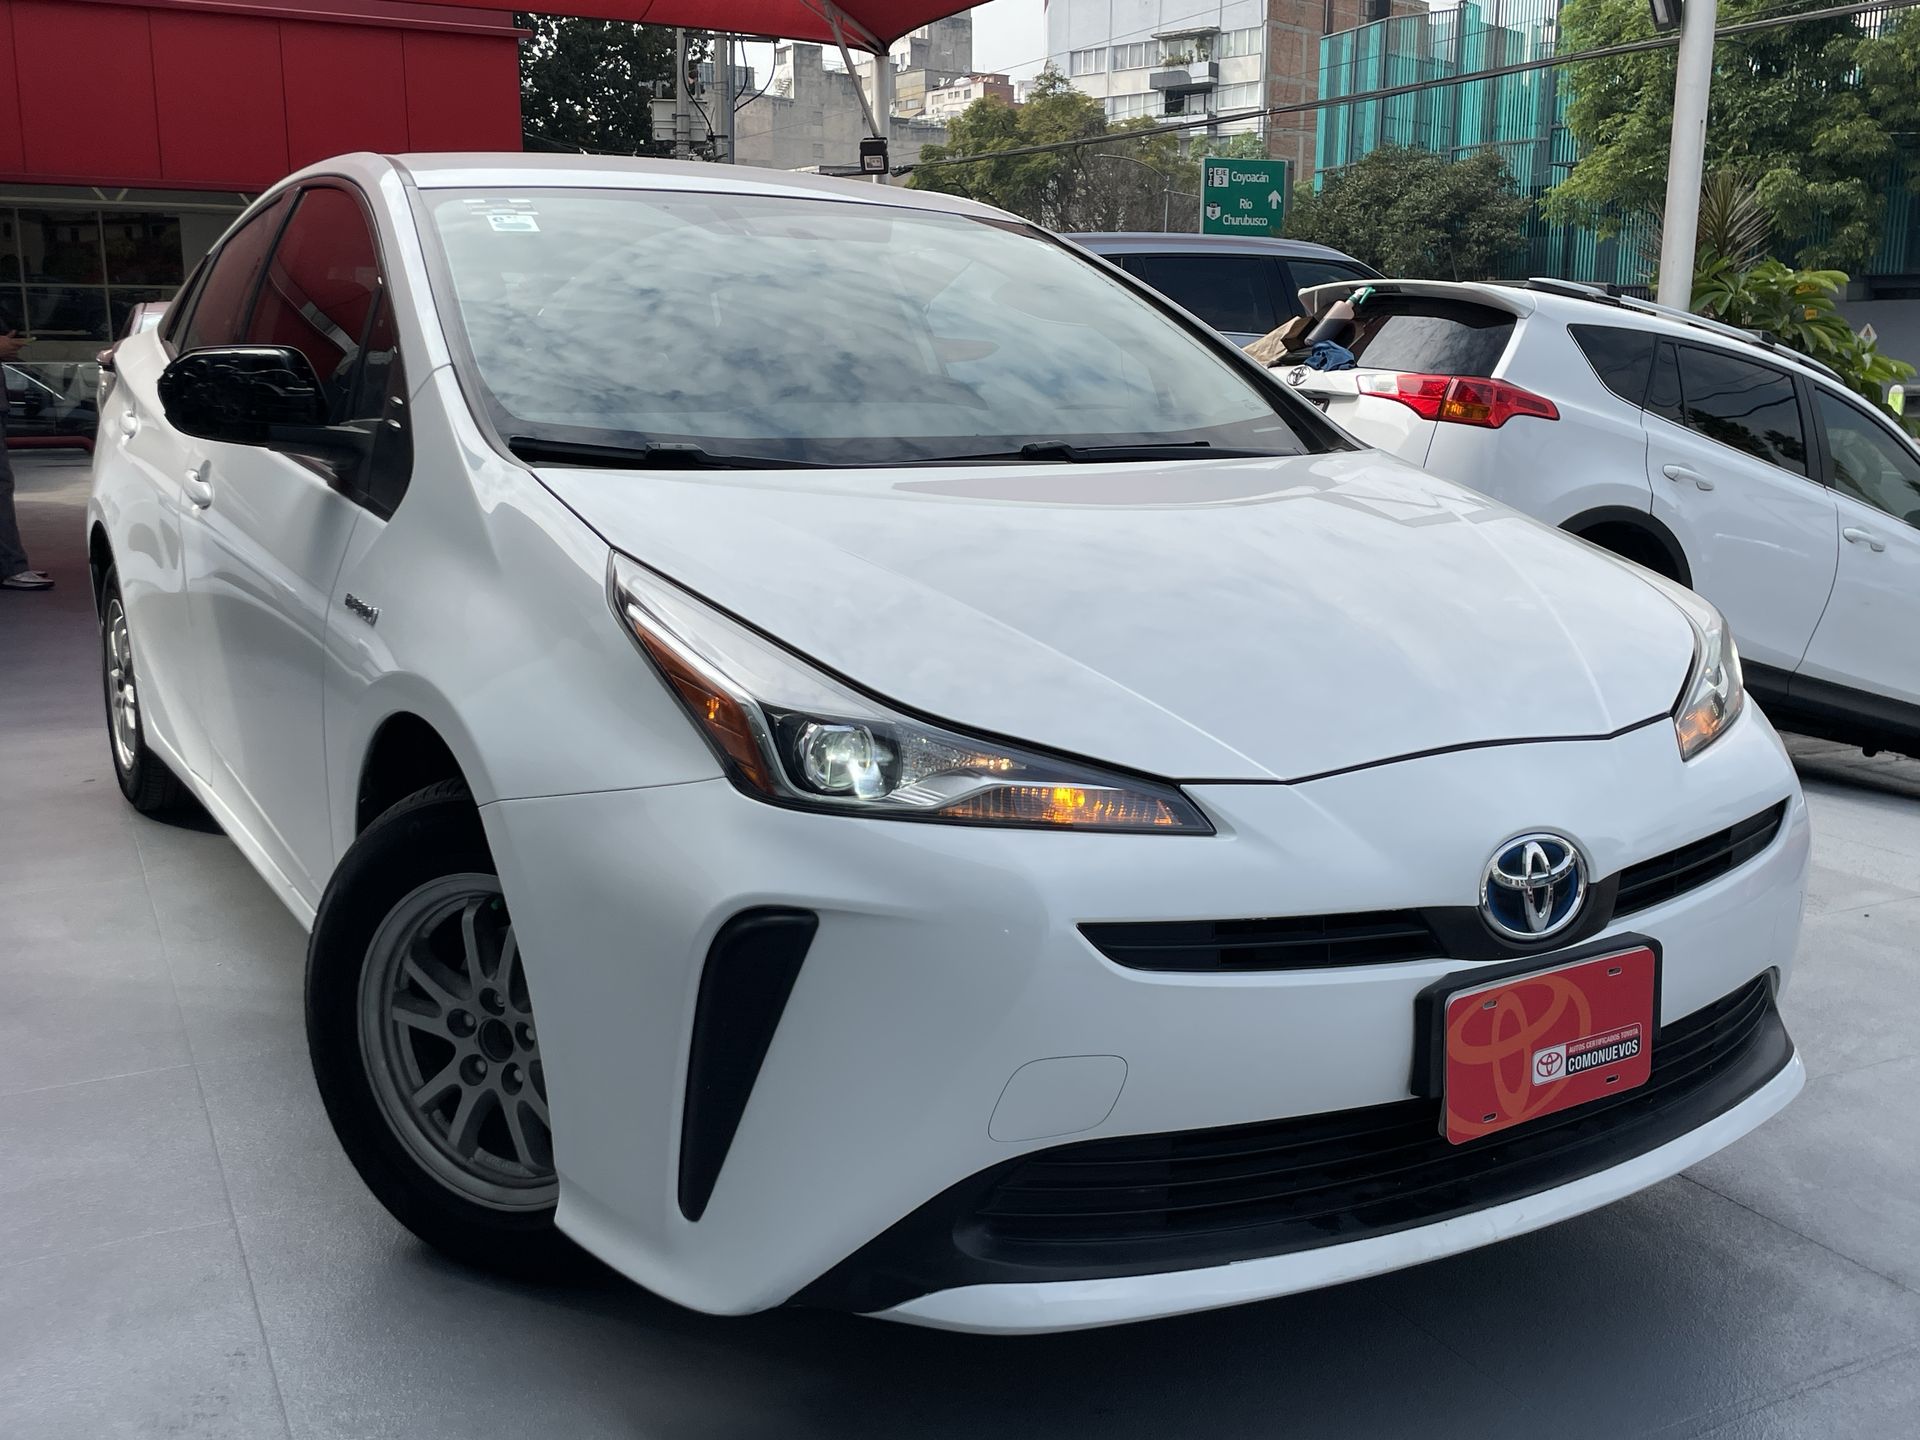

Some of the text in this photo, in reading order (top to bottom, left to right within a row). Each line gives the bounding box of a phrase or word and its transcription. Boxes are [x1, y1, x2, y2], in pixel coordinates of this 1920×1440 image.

[1218, 176, 1224, 185] 3
[1231, 171, 1269, 185] Coyoacán
[1239, 198, 1253, 209] Río
[1223, 213, 1268, 226] Churubusco
[1569, 1043, 1585, 1053] AUTOS
[1586, 1033, 1620, 1048] CERTIFICADOS
[1568, 1039, 1638, 1072] COMONUEVOS
